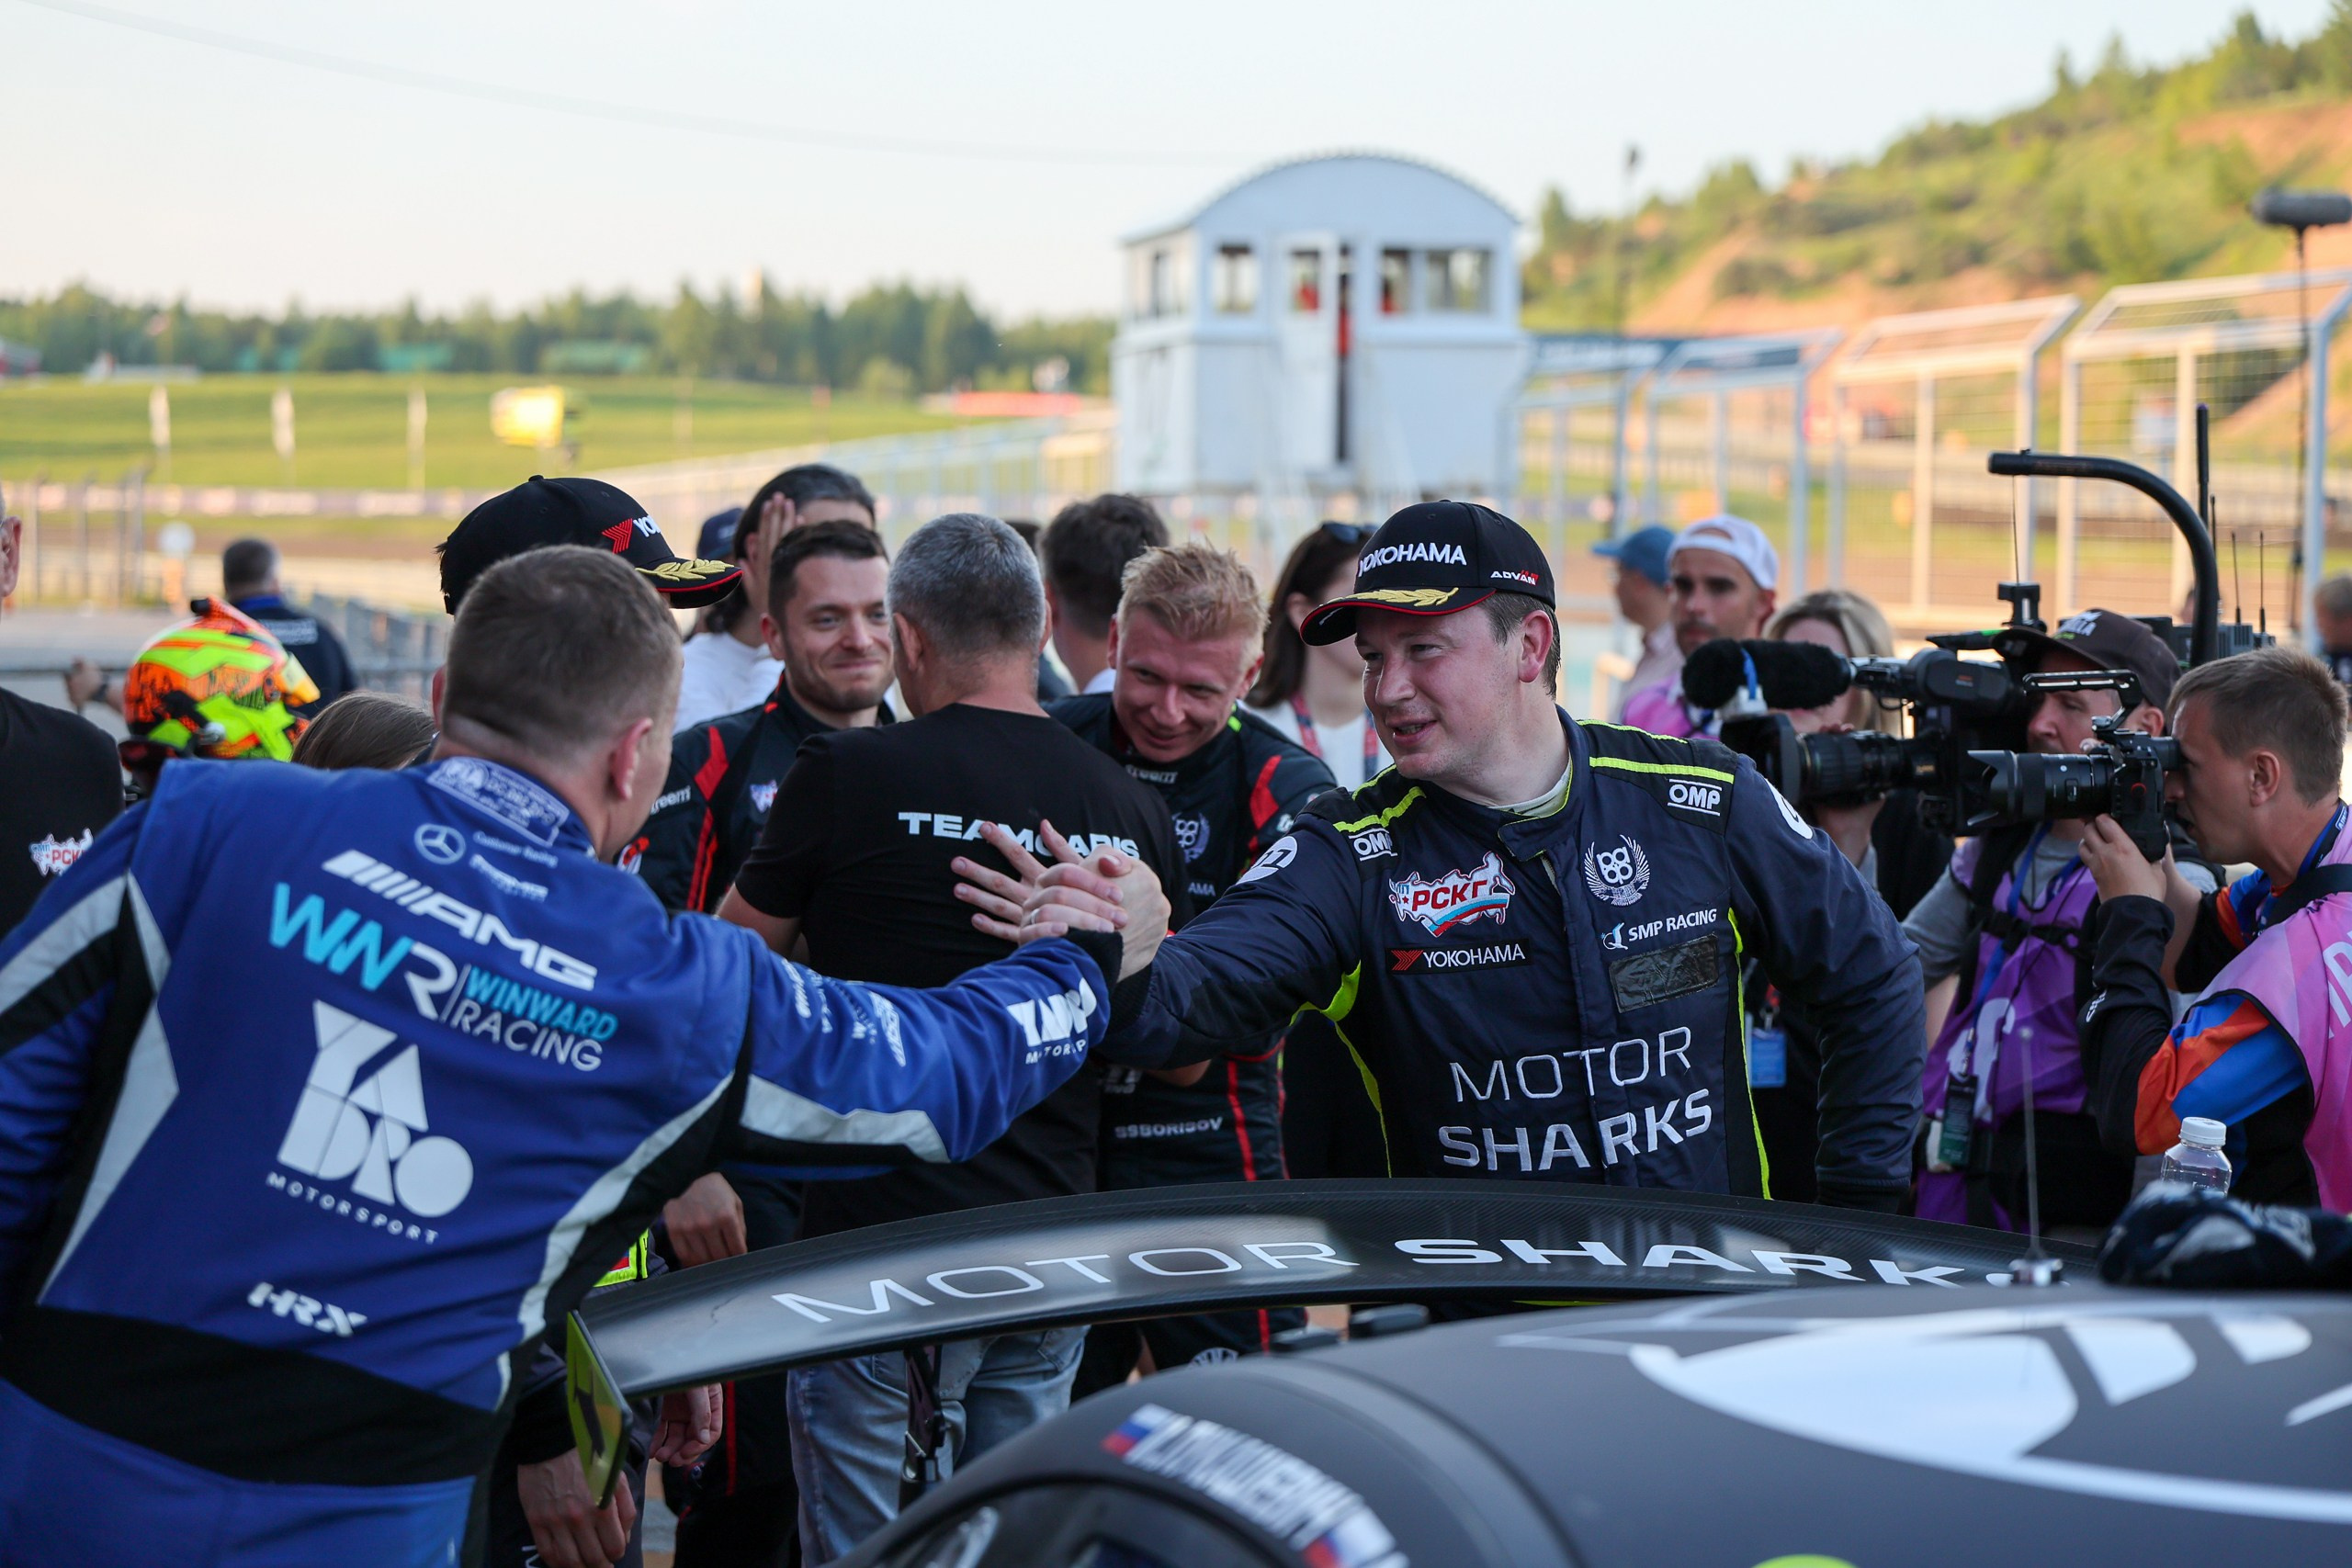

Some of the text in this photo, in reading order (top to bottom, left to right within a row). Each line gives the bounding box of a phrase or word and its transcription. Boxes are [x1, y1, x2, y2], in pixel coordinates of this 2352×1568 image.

[1358, 542, 1467, 578] YOKOHAMA
[1490, 570, 1537, 586] ADVAN
[1668, 784, 1721, 810] OMP
[1411, 879, 1488, 912] РСКГ
[1628, 908, 1717, 942] SMP RACING
[1423, 943, 1526, 969] YOKOHAMA
[467, 965, 618, 1043] WINWARD
[452, 998, 604, 1073] RACING
[1449, 1026, 1693, 1103] MOTOR
[1439, 1089, 1712, 1172] SHARKS
[266, 1170, 439, 1246] MOTORSPORT
[246, 1281, 368, 1337] HRX
[770, 1241, 1361, 1323] MOTOR
